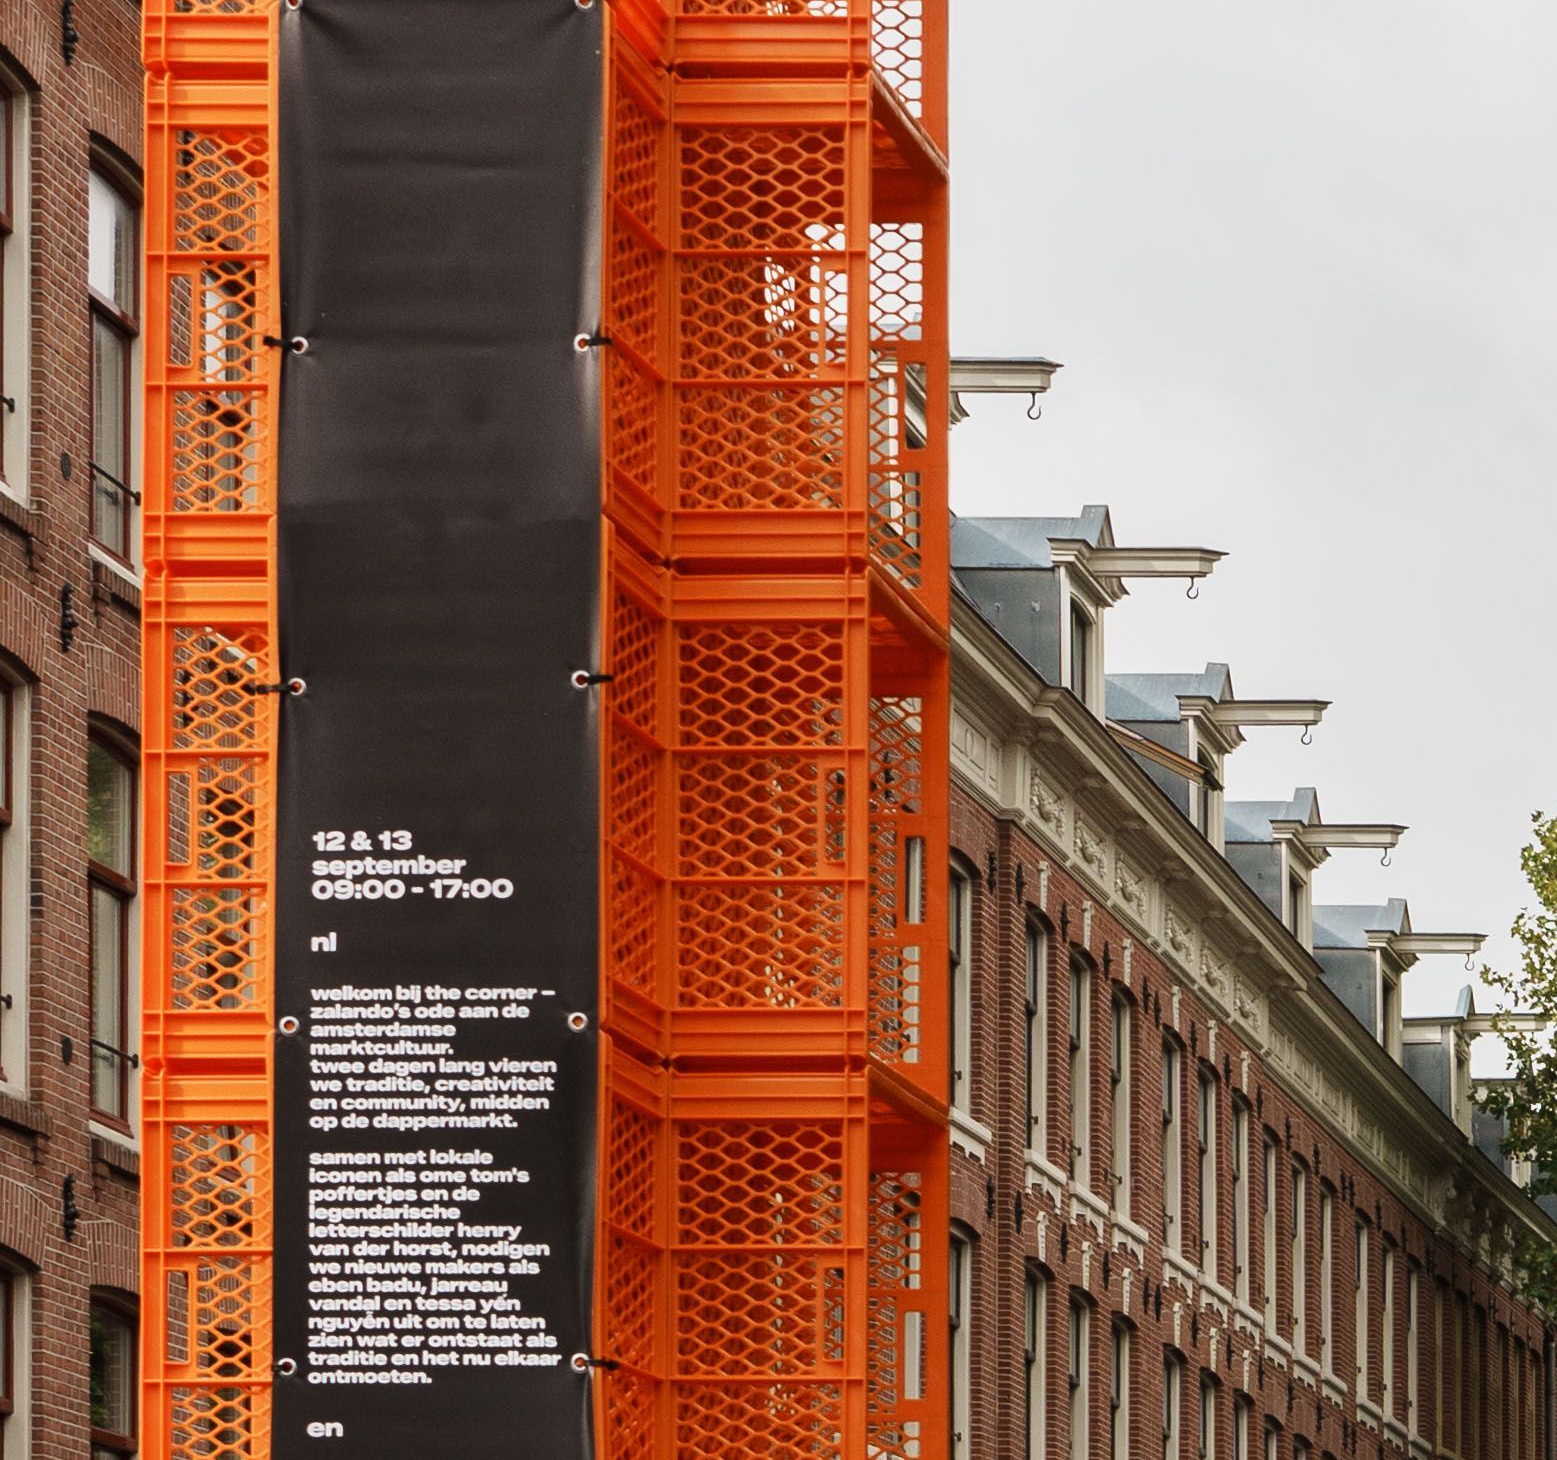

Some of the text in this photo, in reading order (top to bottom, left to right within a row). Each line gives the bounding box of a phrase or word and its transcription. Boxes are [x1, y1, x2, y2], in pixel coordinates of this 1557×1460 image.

[312, 830, 413, 852] 12 & 13
[311, 855, 467, 879] september
[311, 879, 406, 900] 09:00
[429, 878, 514, 899] 17:00
[310, 932, 337, 952] nl
[310, 985, 393, 1001] welkom
[395, 985, 422, 1004] bij
[423, 984, 462, 1000] the
[464, 988, 538, 1000] corner
[413, 1003, 456, 1019] ode
[458, 1006, 499, 1019] aan
[501, 1002, 530, 1018] de
[309, 1021, 457, 1037] amsterdamse
[309, 1040, 454, 1055] marktcultuur.
[309, 1058, 558, 1077] twee dagen lang vieren
[309, 1076, 555, 1095] we traditie, creativiteit
[309, 1094, 550, 1113] en community, midden
[308, 1112, 519, 1132] op de dappermarkt.
[306, 1422, 344, 1438] en
